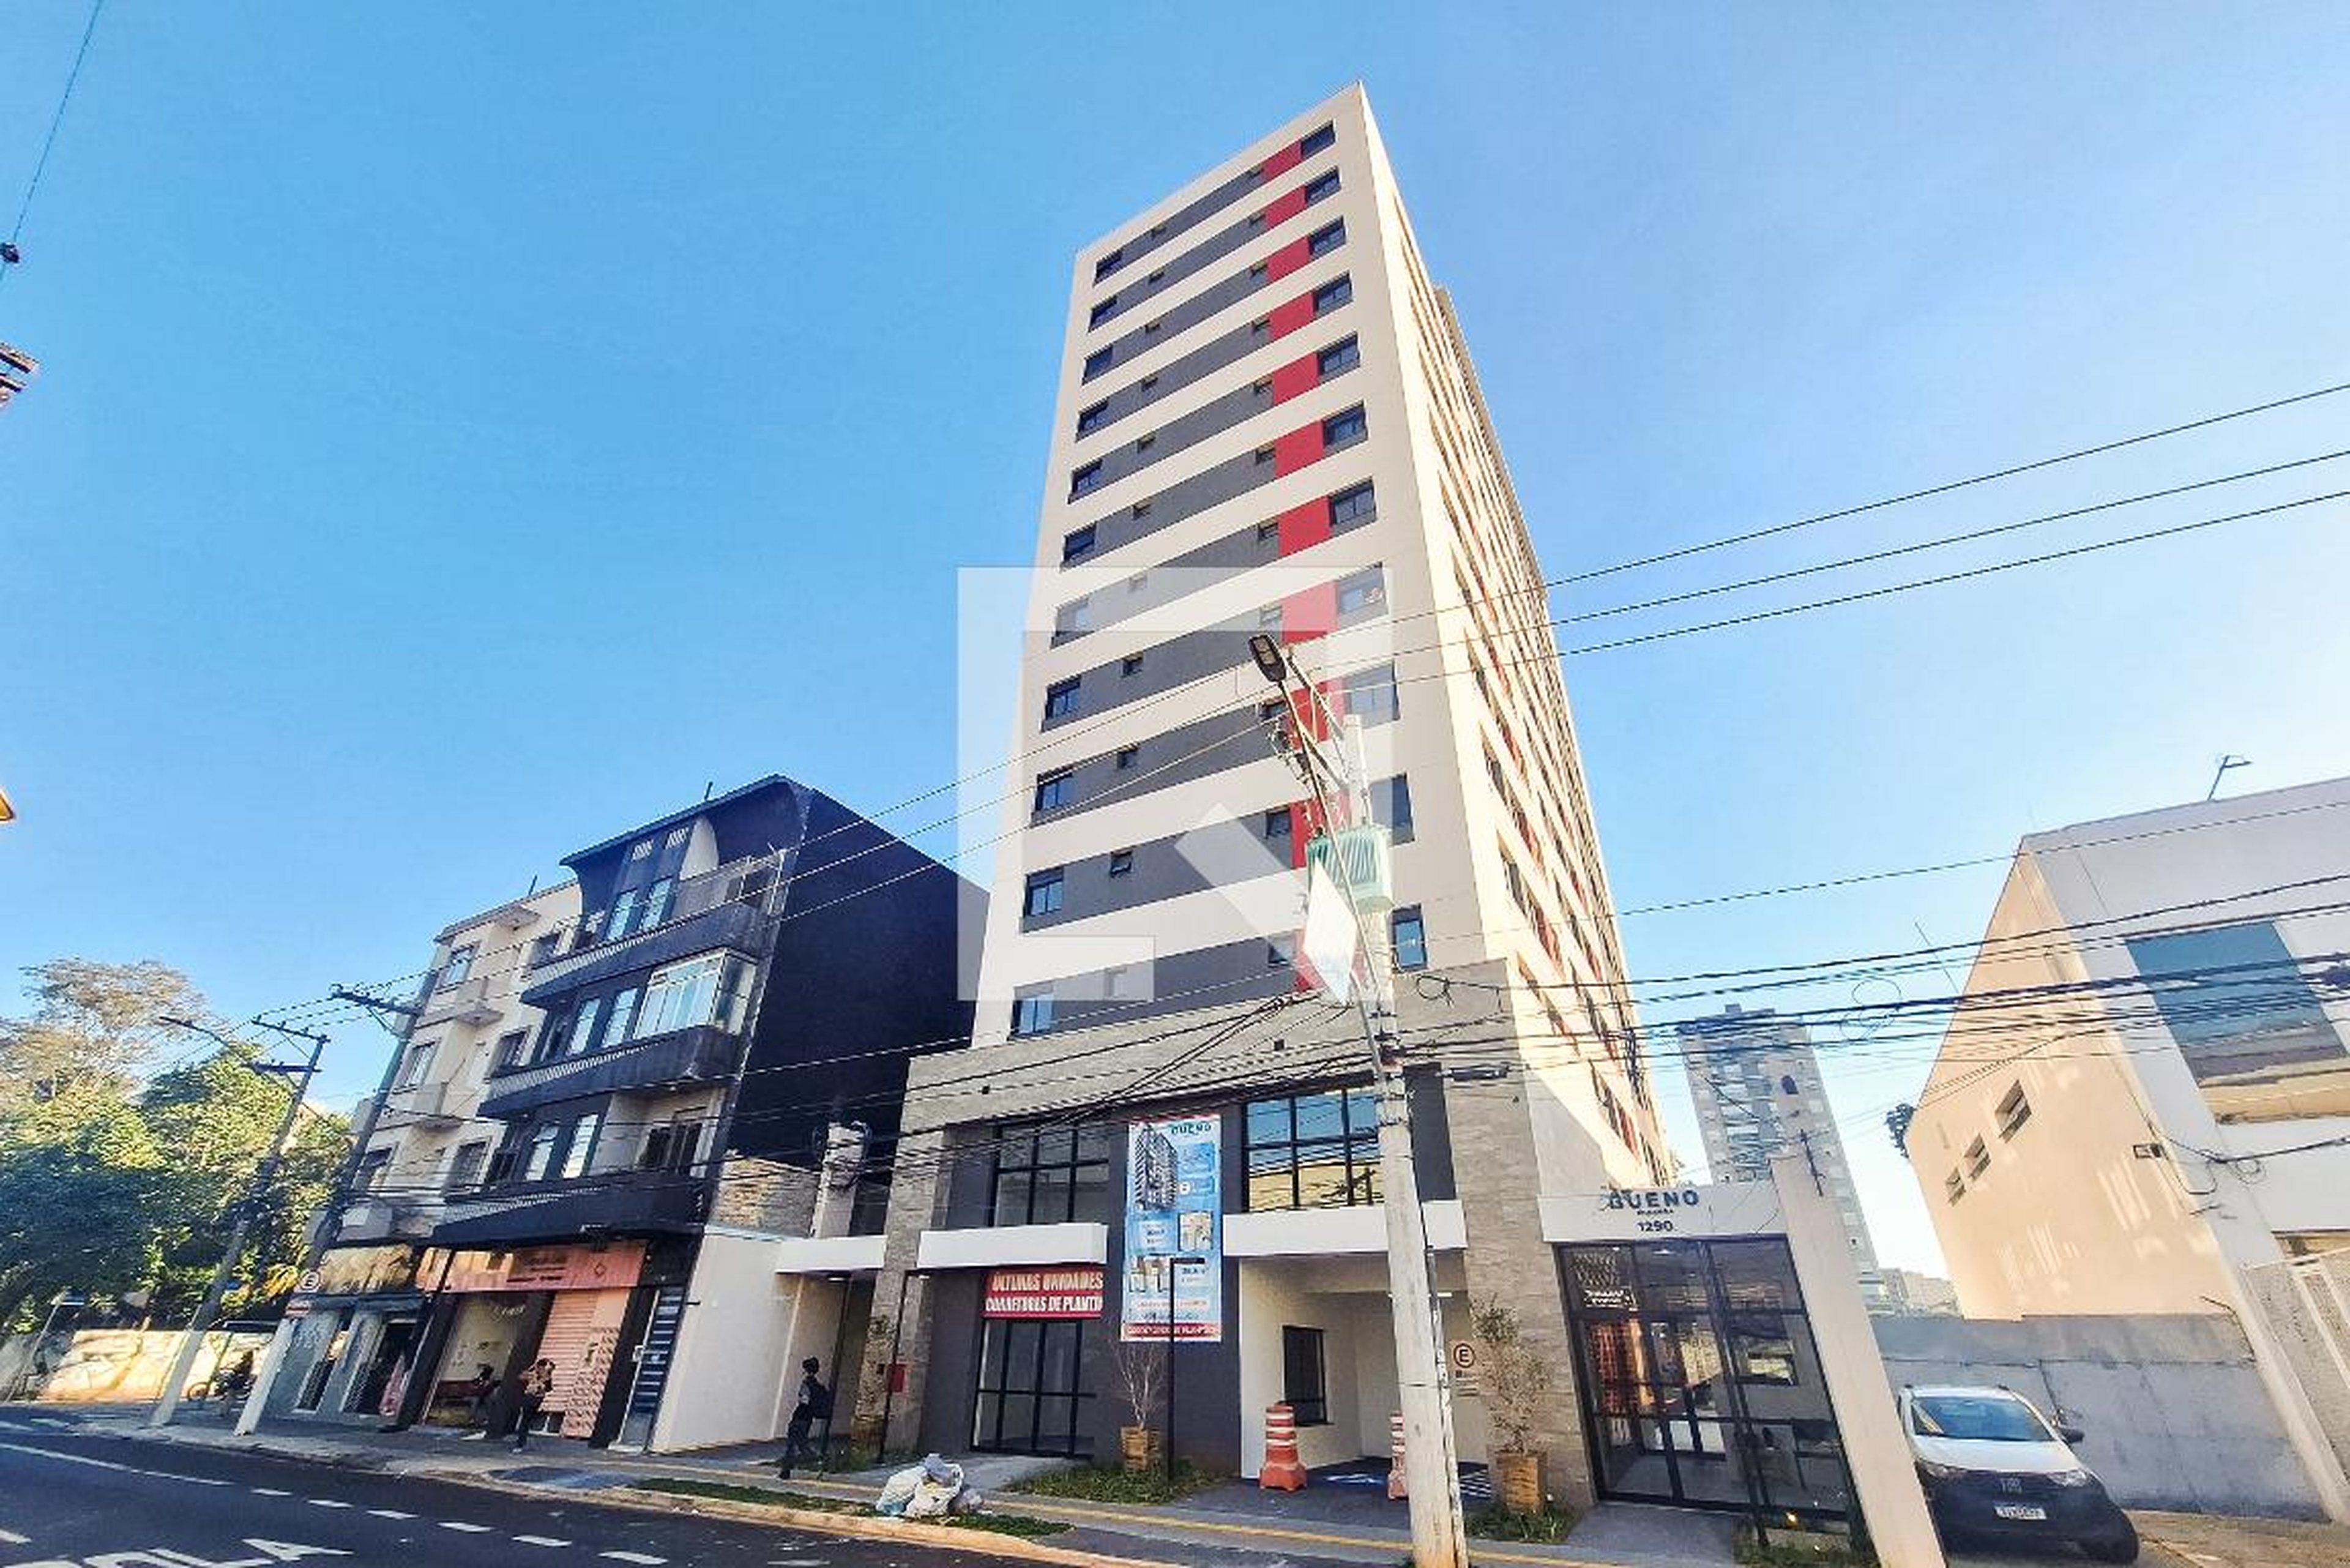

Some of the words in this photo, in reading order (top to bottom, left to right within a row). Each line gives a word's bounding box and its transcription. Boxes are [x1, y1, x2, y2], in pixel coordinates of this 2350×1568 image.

[1609, 1189, 1699, 1209] BUENO
[1637, 1220, 1674, 1232] 1290
[1047, 1296, 1062, 1312] DE
[1459, 1348, 1470, 1363] E
